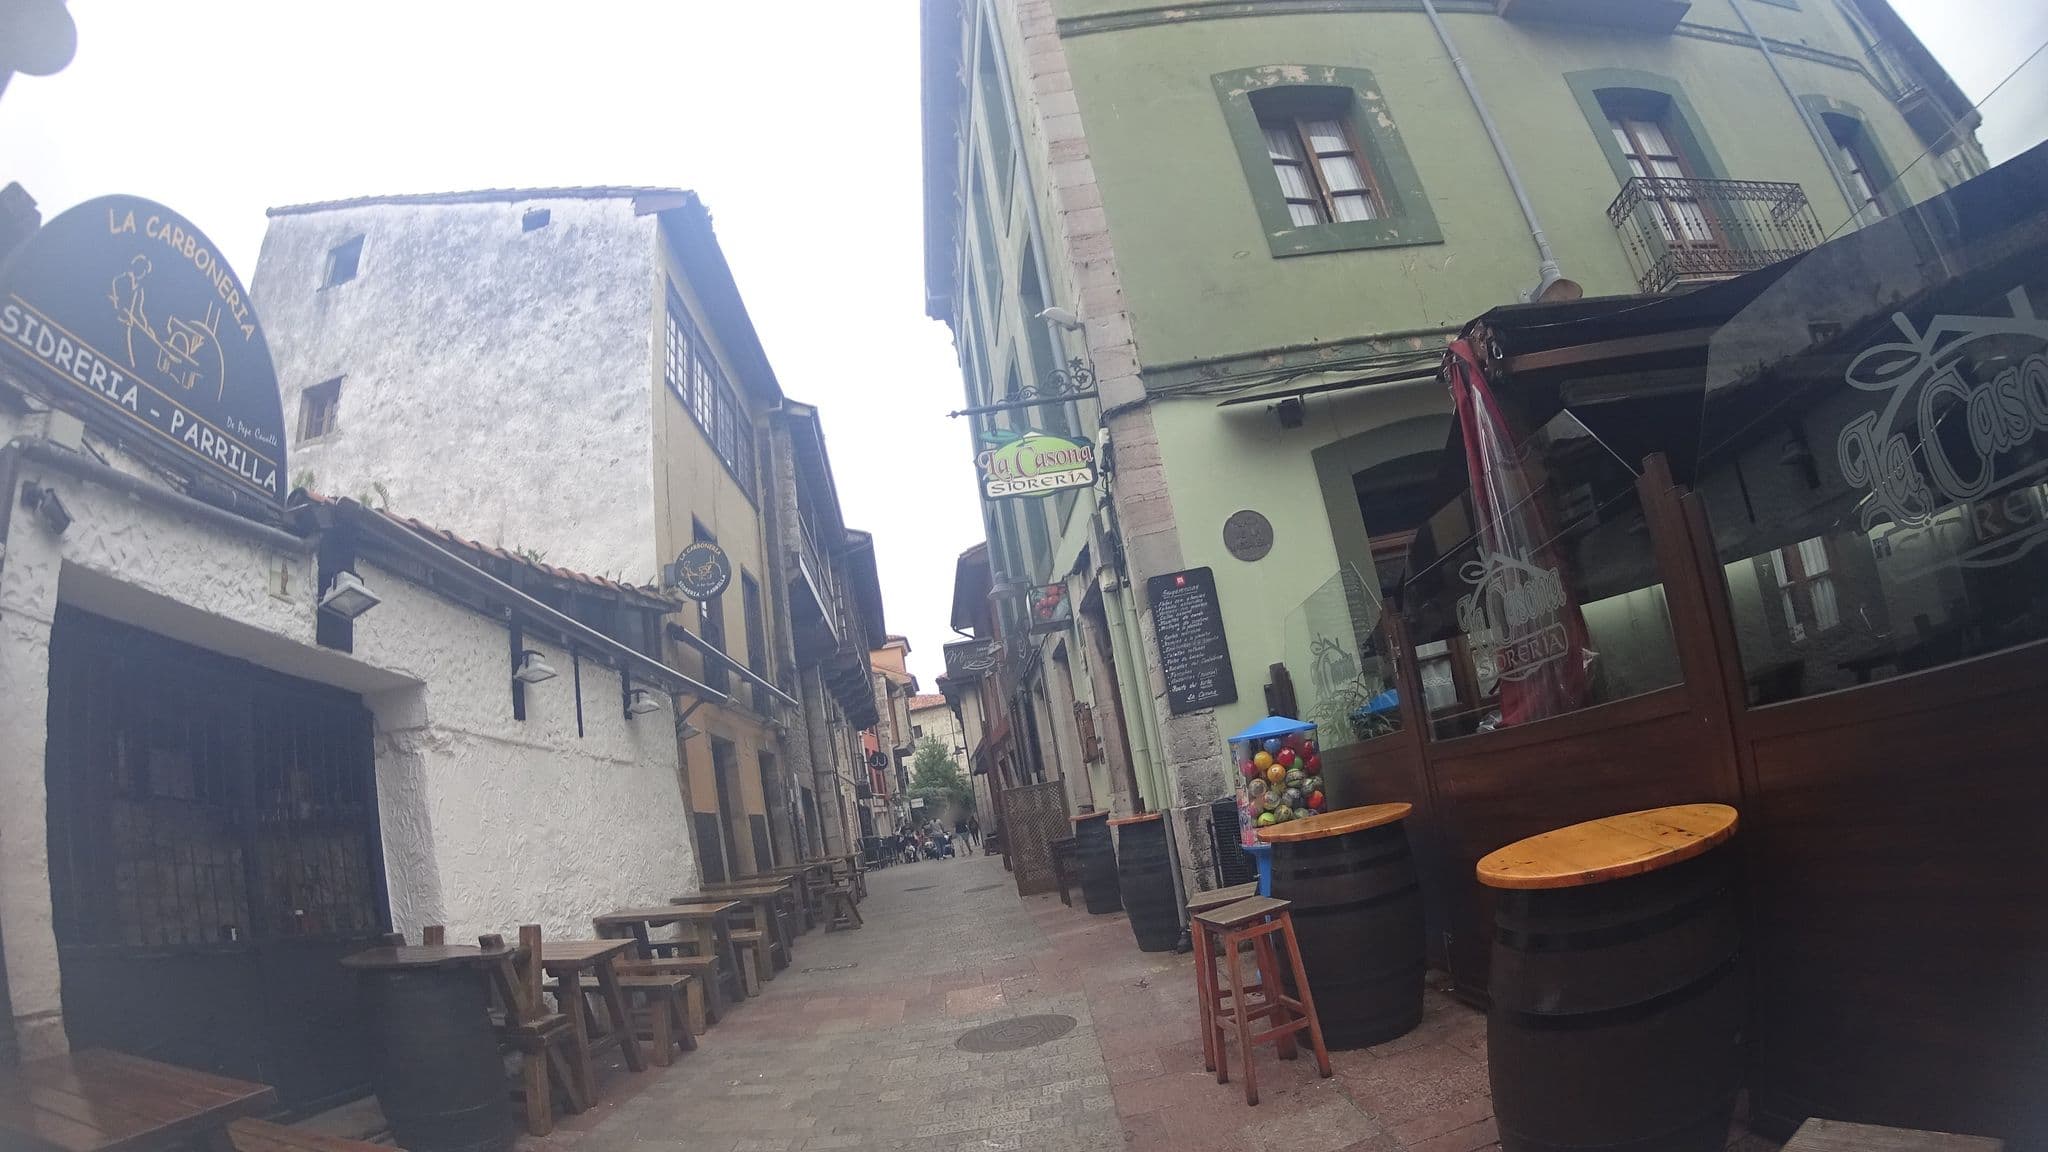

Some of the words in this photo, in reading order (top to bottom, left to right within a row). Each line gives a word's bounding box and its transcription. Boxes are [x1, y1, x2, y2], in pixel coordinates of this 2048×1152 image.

[108, 207, 137, 235] LA
[145, 215, 256, 342] CARBONERIA
[1, 304, 138, 412] SIDRERIA
[170, 410, 278, 494] PARRILLA
[977, 449, 1014, 483] La
[1015, 445, 1094, 478] Casona
